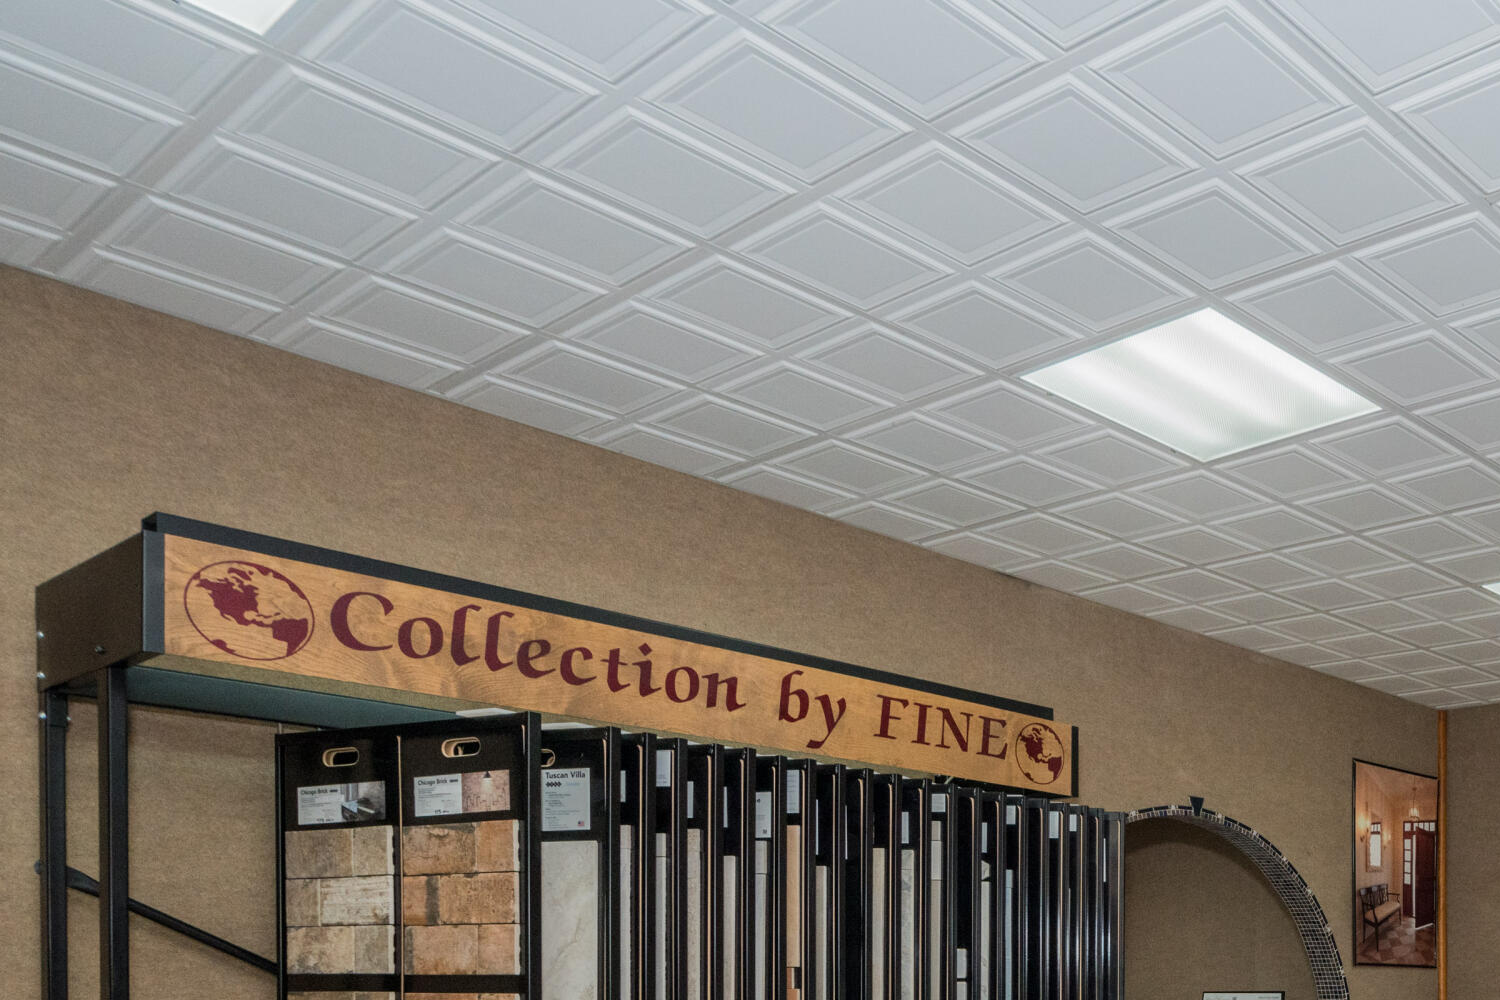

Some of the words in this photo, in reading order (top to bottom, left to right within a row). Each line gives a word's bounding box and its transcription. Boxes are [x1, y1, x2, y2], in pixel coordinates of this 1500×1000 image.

[329, 591, 747, 712] Collection
[778, 669, 848, 750] by
[873, 693, 1009, 761] FINE
[545, 771, 568, 779] Tuscan
[570, 771, 586, 779] Villa
